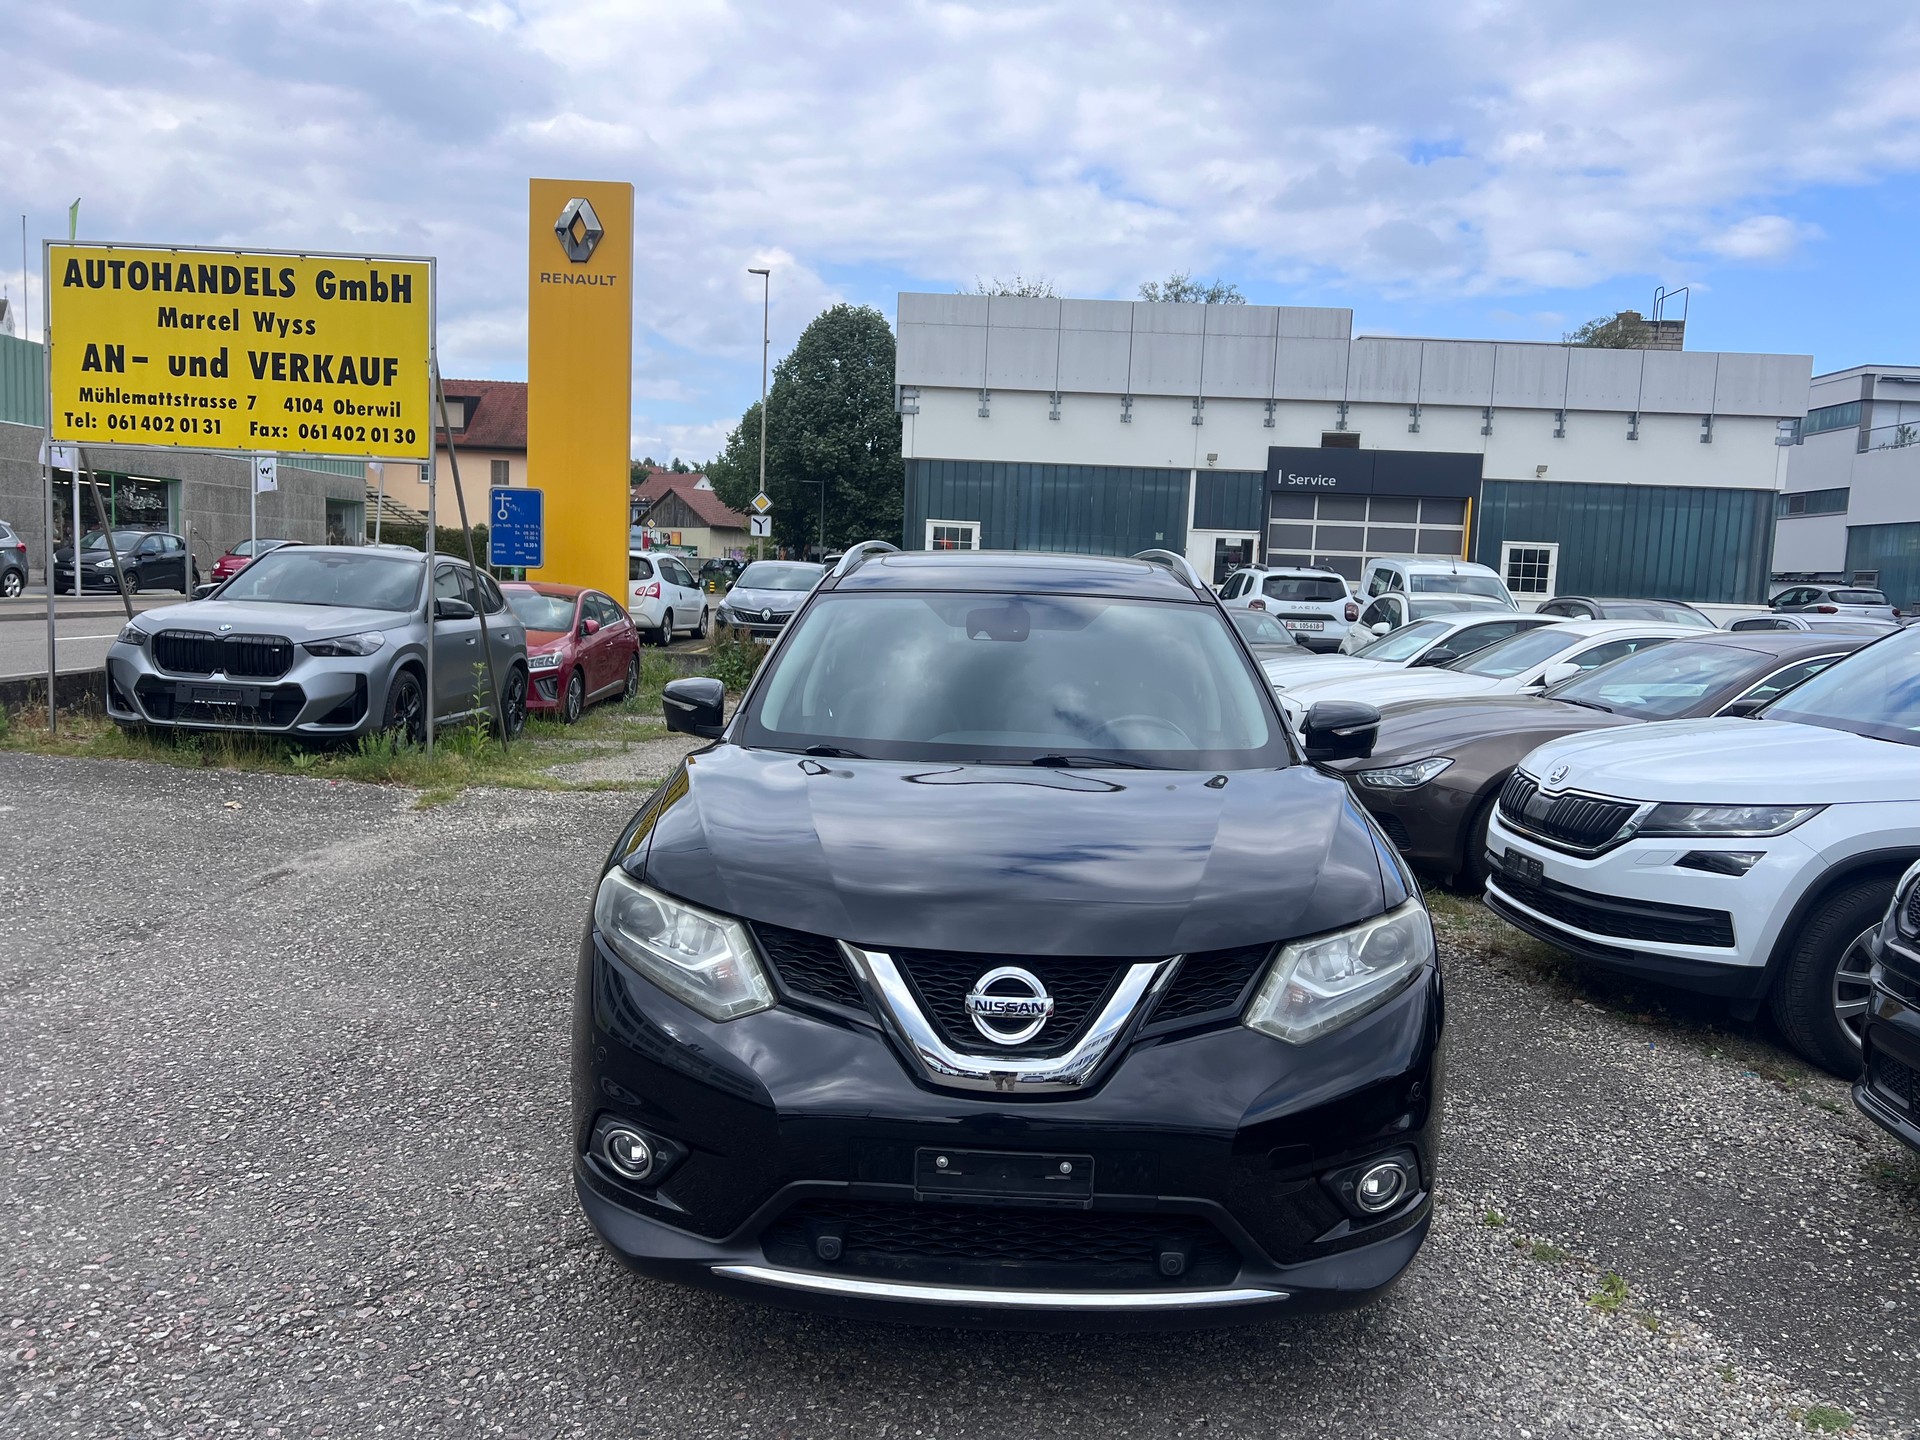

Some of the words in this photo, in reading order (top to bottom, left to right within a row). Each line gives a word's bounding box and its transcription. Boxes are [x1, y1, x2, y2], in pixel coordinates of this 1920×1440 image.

[63, 258, 296, 298] AUTOHANDELS
[315, 269, 412, 303] GmbH
[540, 272, 617, 286] RENAULT
[157, 306, 239, 331] Marcel
[252, 311, 316, 338] Wyss
[168, 346, 229, 378] und
[247, 350, 399, 386] VERKAUF
[79, 387, 237, 410] Mühlemattstrasse
[247, 395, 257, 410] 7
[283, 397, 324, 413] 4104
[333, 399, 401, 418] Oberwil
[64, 412, 97, 428] Tel:
[249, 421, 288, 438] Fax:
[1288, 473, 1337, 486] Service
[974, 1000, 1044, 1013] NISSAN
